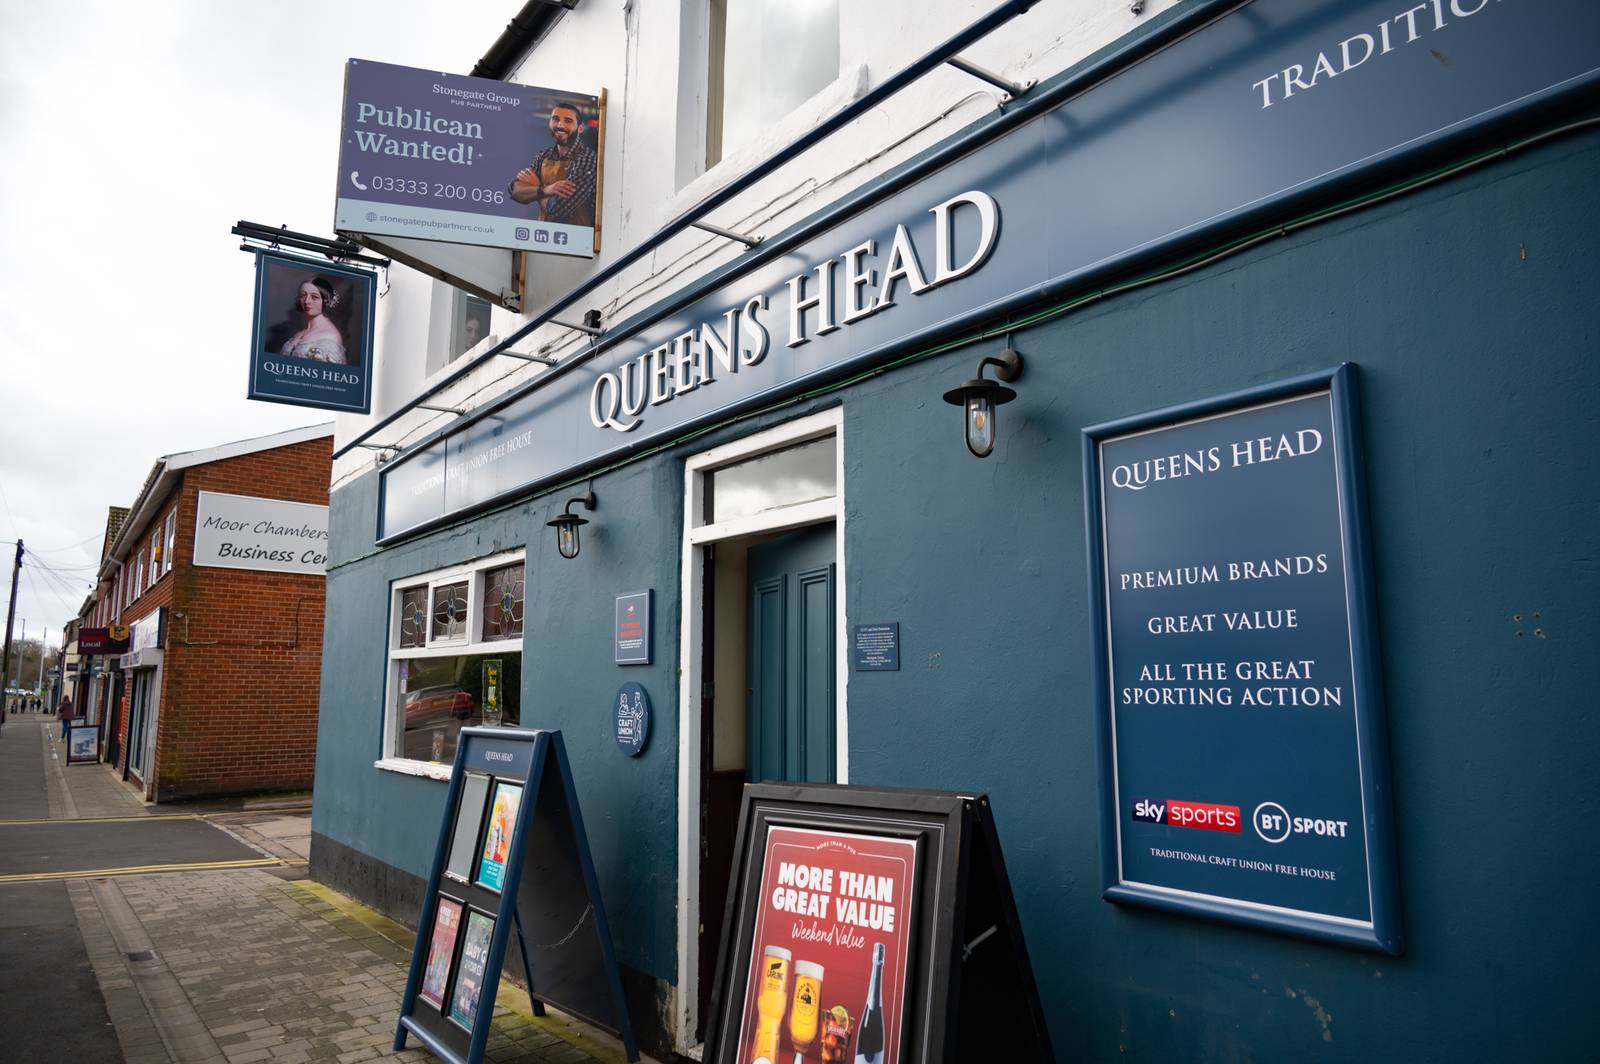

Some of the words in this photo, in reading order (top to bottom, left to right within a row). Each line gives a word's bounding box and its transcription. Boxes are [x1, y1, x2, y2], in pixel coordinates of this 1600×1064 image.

[432, 83, 485, 100] Stonegate
[486, 91, 520, 107] Group
[466, 101, 502, 112] PARTNERS
[356, 102, 484, 140] Publican
[354, 130, 474, 166] Wanted!
[372, 175, 428, 196] 03333
[434, 183, 467, 201] 200
[471, 187, 504, 204] 036
[379, 215, 495, 234] stonegatepubpartners.co.uk
[589, 294, 770, 432] QUEENS
[784, 190, 1002, 349] HEAD
[263, 361, 319, 379] QUEENS
[322, 370, 359, 385] HEAD
[489, 443, 506, 463] FREE
[506, 431, 533, 453] HOUSE
[1111, 447, 1221, 490] QUEENS
[1231, 428, 1323, 468] HEAD
[203, 516, 250, 532] Moor
[217, 542, 295, 562] Business
[1120, 565, 1220, 590] PREMIUM
[1229, 554, 1328, 581] BRANDS
[1148, 613, 1216, 634] GREAT
[1223, 609, 1299, 631] VALUE
[1140, 664, 1176, 681] ALL
[1182, 663, 1227, 681] THE
[1235, 660, 1315, 681] GREAT
[1122, 687, 1233, 706] SPORTING
[1240, 687, 1343, 706] ACTION
[617, 718, 633, 727] CRAFT
[617, 727, 633, 736] UNION
[1135, 800, 1165, 822] sky
[1171, 805, 1236, 827] sports
[1261, 814, 1283, 831] BT
[1293, 817, 1348, 838] SPORT
[1150, 848, 1207, 864] TRADITIONAL
[1208, 855, 1237, 867] CRAFT
[1239, 859, 1272, 873] UNION
[1275, 863, 1298, 876] FREE
[1300, 867, 1336, 882] HOUSE
[778, 862, 833, 893] MORE
[839, 871, 894, 904] THAN
[772, 887, 829, 919] GREAT
[836, 898, 896, 933] VALUE
[791, 919, 836, 945] Weekend
[835, 924, 865, 949] Value
